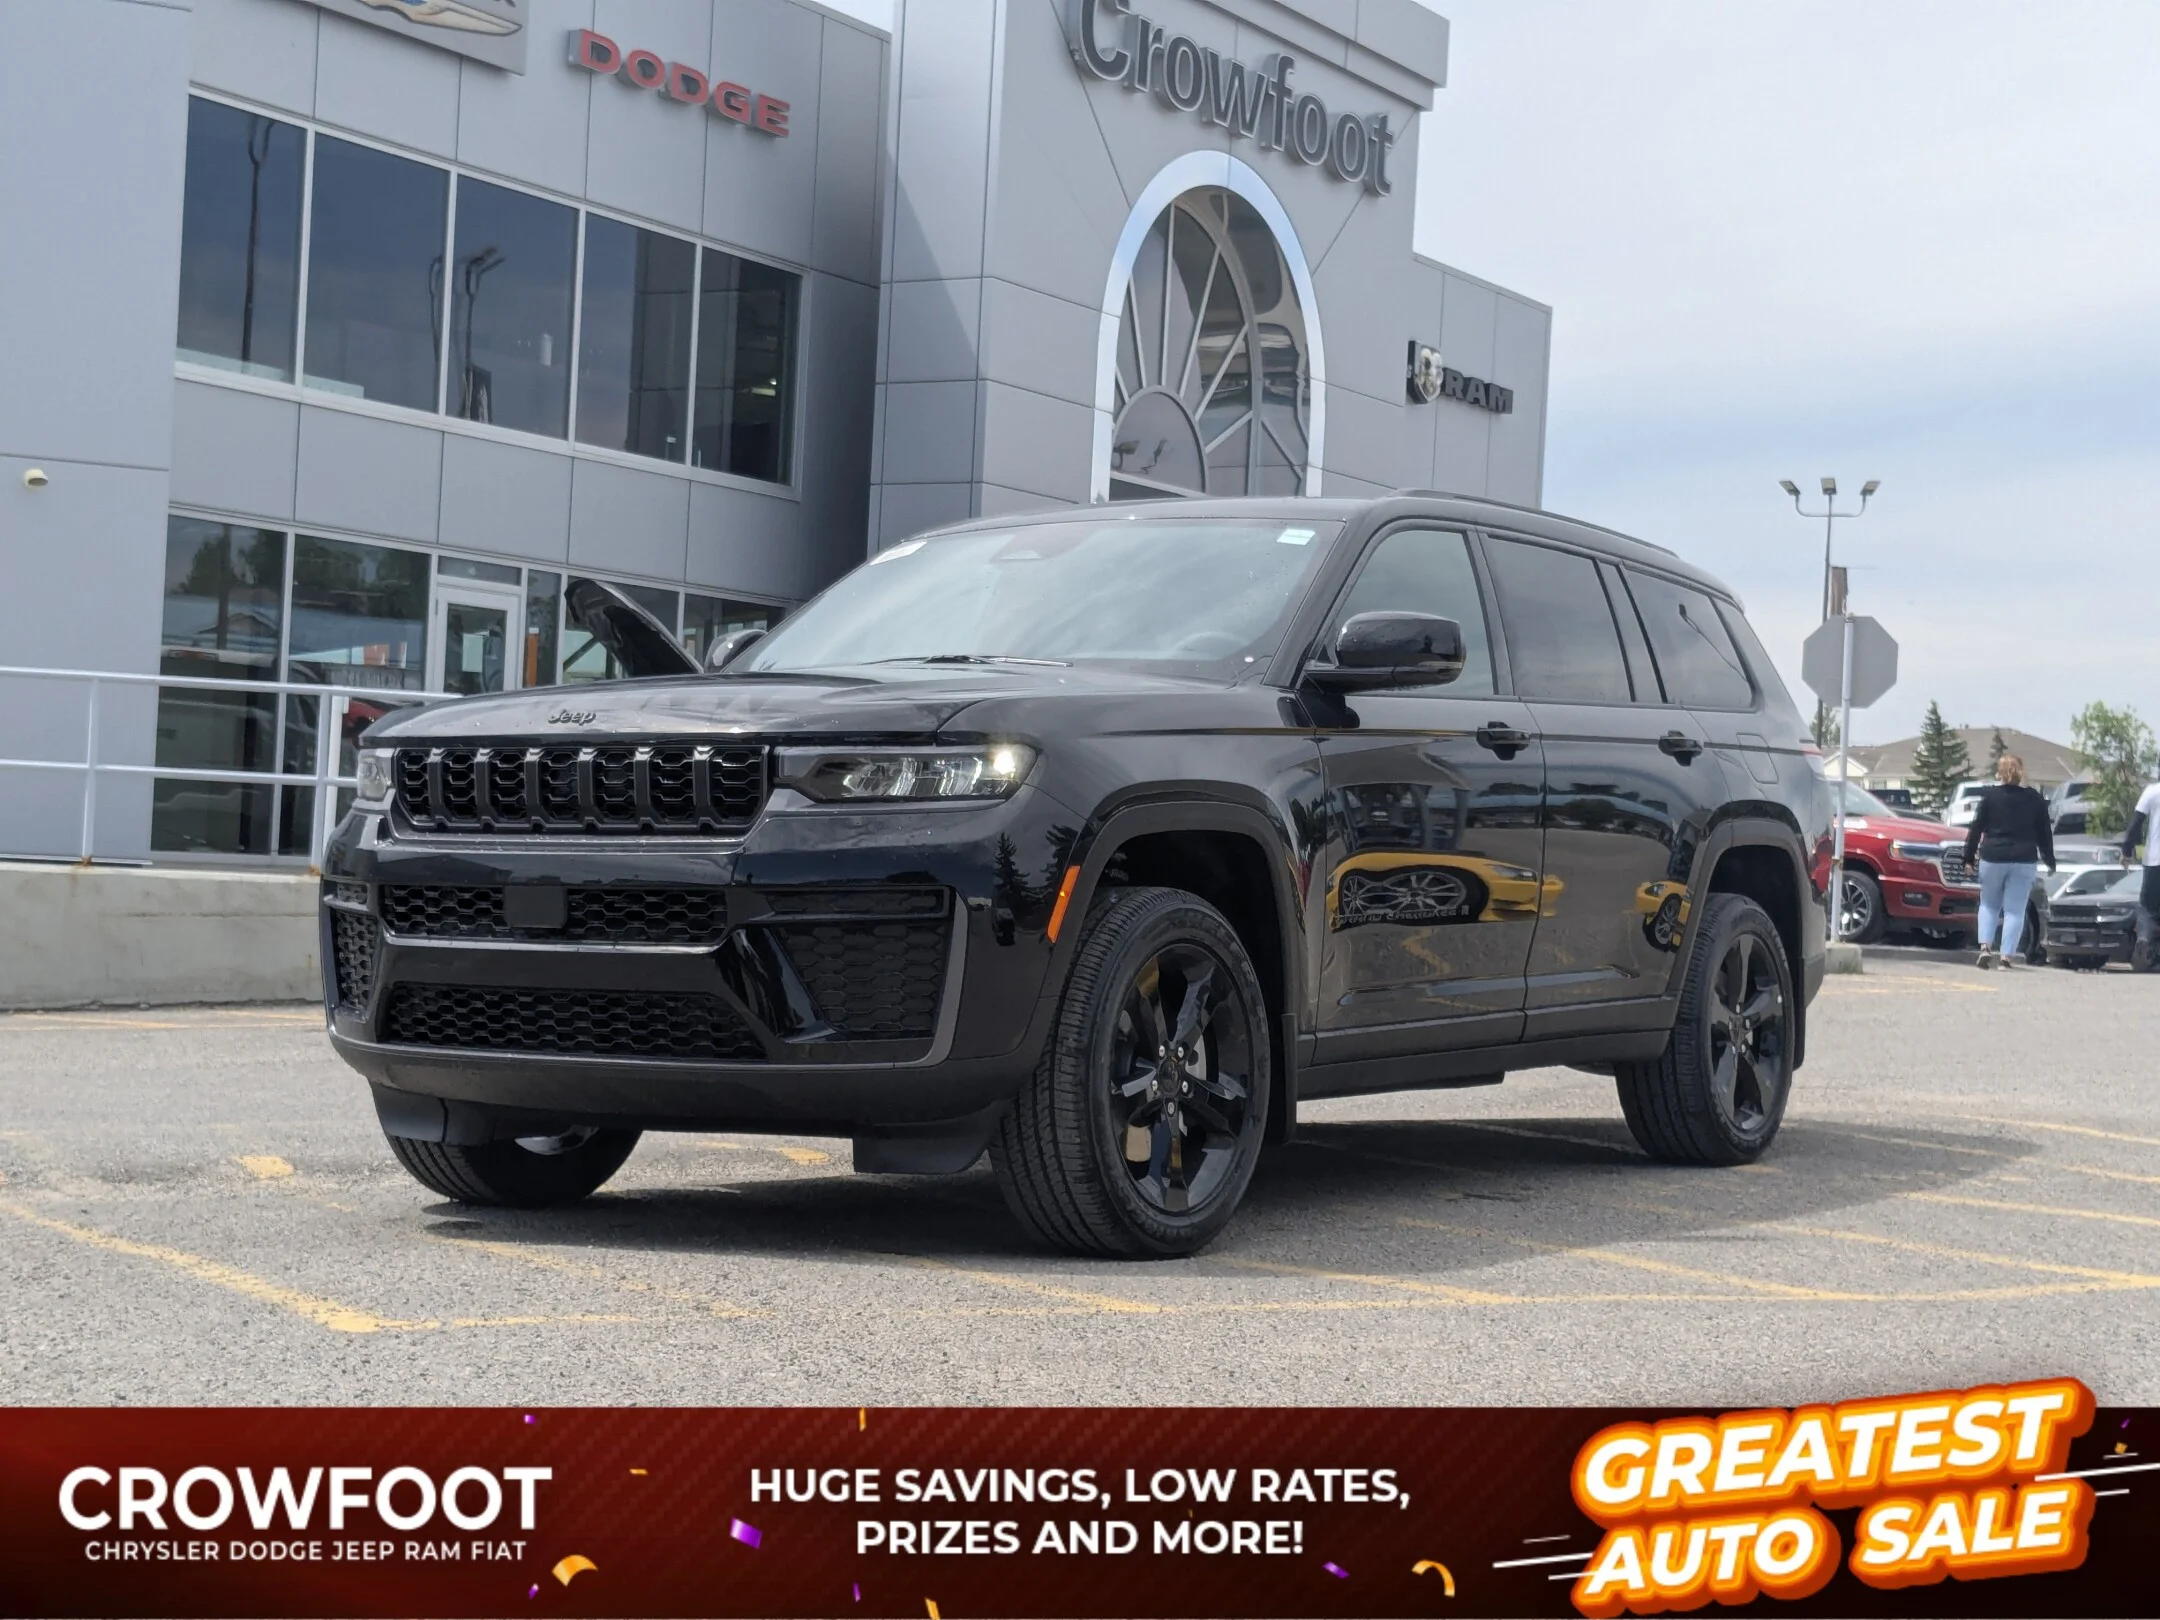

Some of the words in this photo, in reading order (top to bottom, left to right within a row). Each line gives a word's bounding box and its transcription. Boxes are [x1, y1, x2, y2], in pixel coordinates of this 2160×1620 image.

[576, 28, 791, 138] DODGE
[1077, 0, 1394, 197] Crowfoot
[1442, 367, 1513, 414] RAM
[548, 709, 596, 726] Jeep
